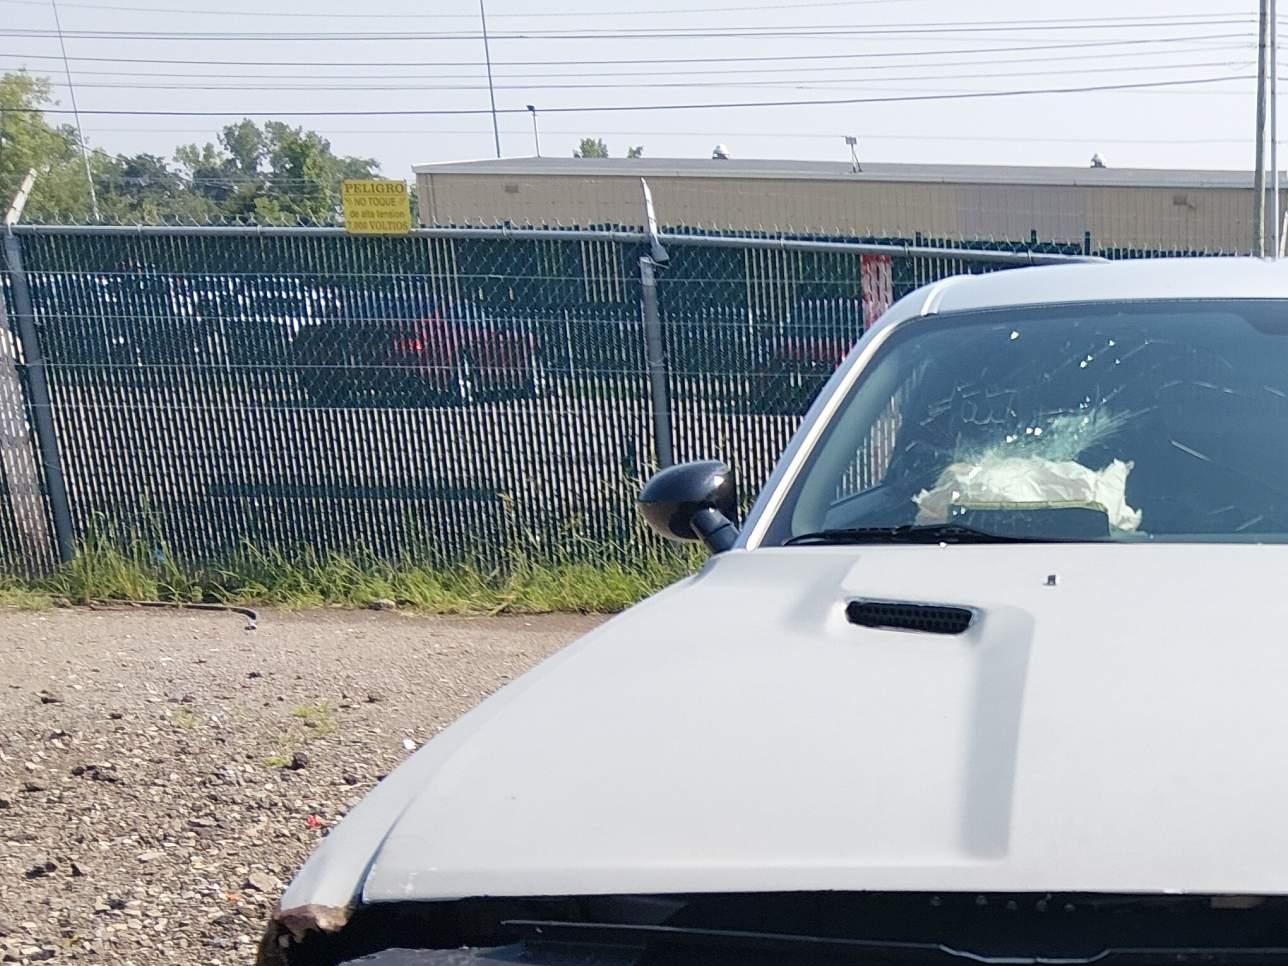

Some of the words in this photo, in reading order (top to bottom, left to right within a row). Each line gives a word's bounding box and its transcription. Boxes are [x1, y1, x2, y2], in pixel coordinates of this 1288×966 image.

[345, 183, 405, 194] PELIGRO
[354, 198, 367, 206] NO
[368, 197, 397, 206] TOQUE
[369, 221, 409, 231] VOLTIOS
